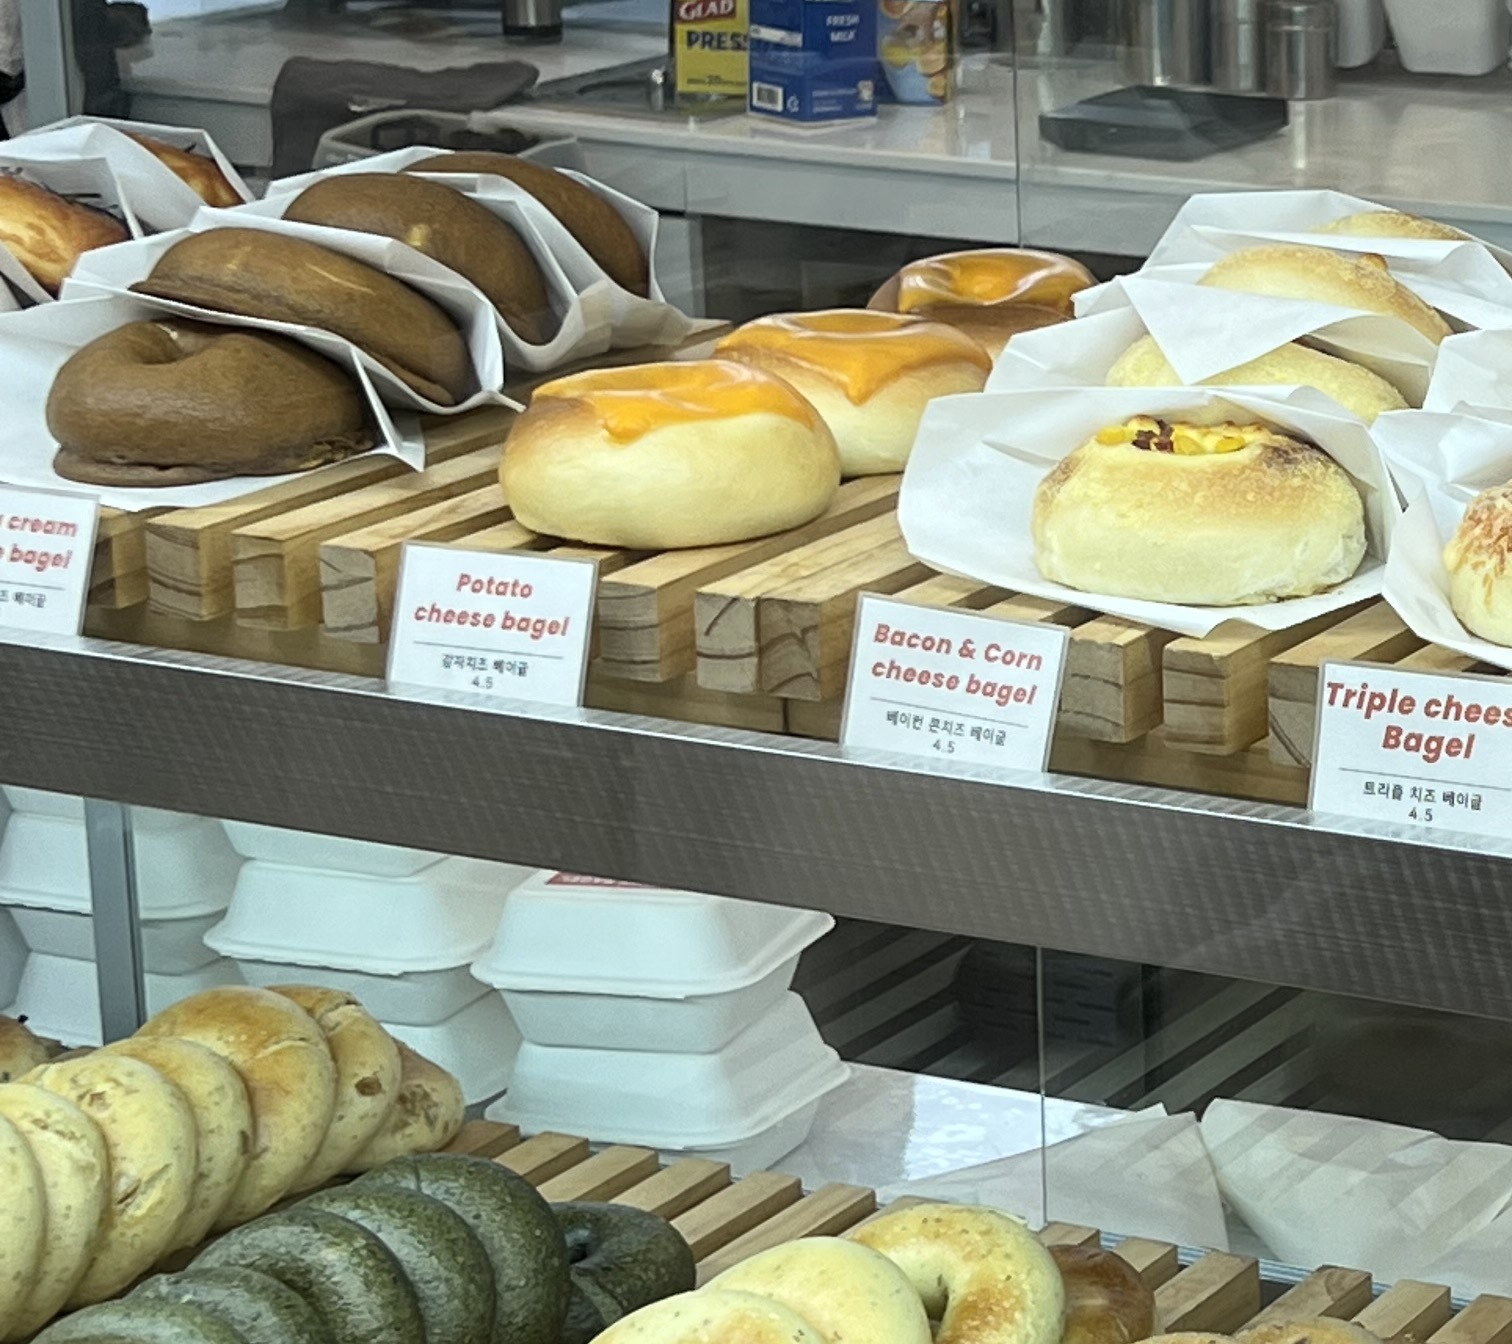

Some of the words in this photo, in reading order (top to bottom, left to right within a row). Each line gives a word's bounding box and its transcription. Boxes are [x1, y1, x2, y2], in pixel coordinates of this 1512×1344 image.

[8, 515, 78, 537] cream
[9, 544, 73, 572] bagel
[456, 573, 533, 598] Potato
[414, 602, 495, 628] cheese
[501, 611, 570, 640] bagel
[873, 623, 952, 655] Bacon
[958, 639, 976, 660] &
[984, 643, 1043, 671] Corn
[442, 654, 488, 671] 감자치즈
[493, 660, 529, 677] 베이글
[472, 676, 493, 689] 4.5
[871, 660, 960, 690] cheese
[966, 673, 1038, 707] bagel
[1327, 681, 1416, 719] Triple
[886, 710, 924, 730] 베이컨
[928, 717, 966, 737] 콘치즈
[970, 726, 1007, 746] 베이글
[932, 739, 955, 754] 4.5
[1382, 724, 1475, 763] Bagel
[1363, 781, 1403, 802] 트리플
[1410, 787, 1436, 803] 치즈
[1442, 790, 1482, 811] 베이글
[1408, 807, 1433, 822] 4.5
